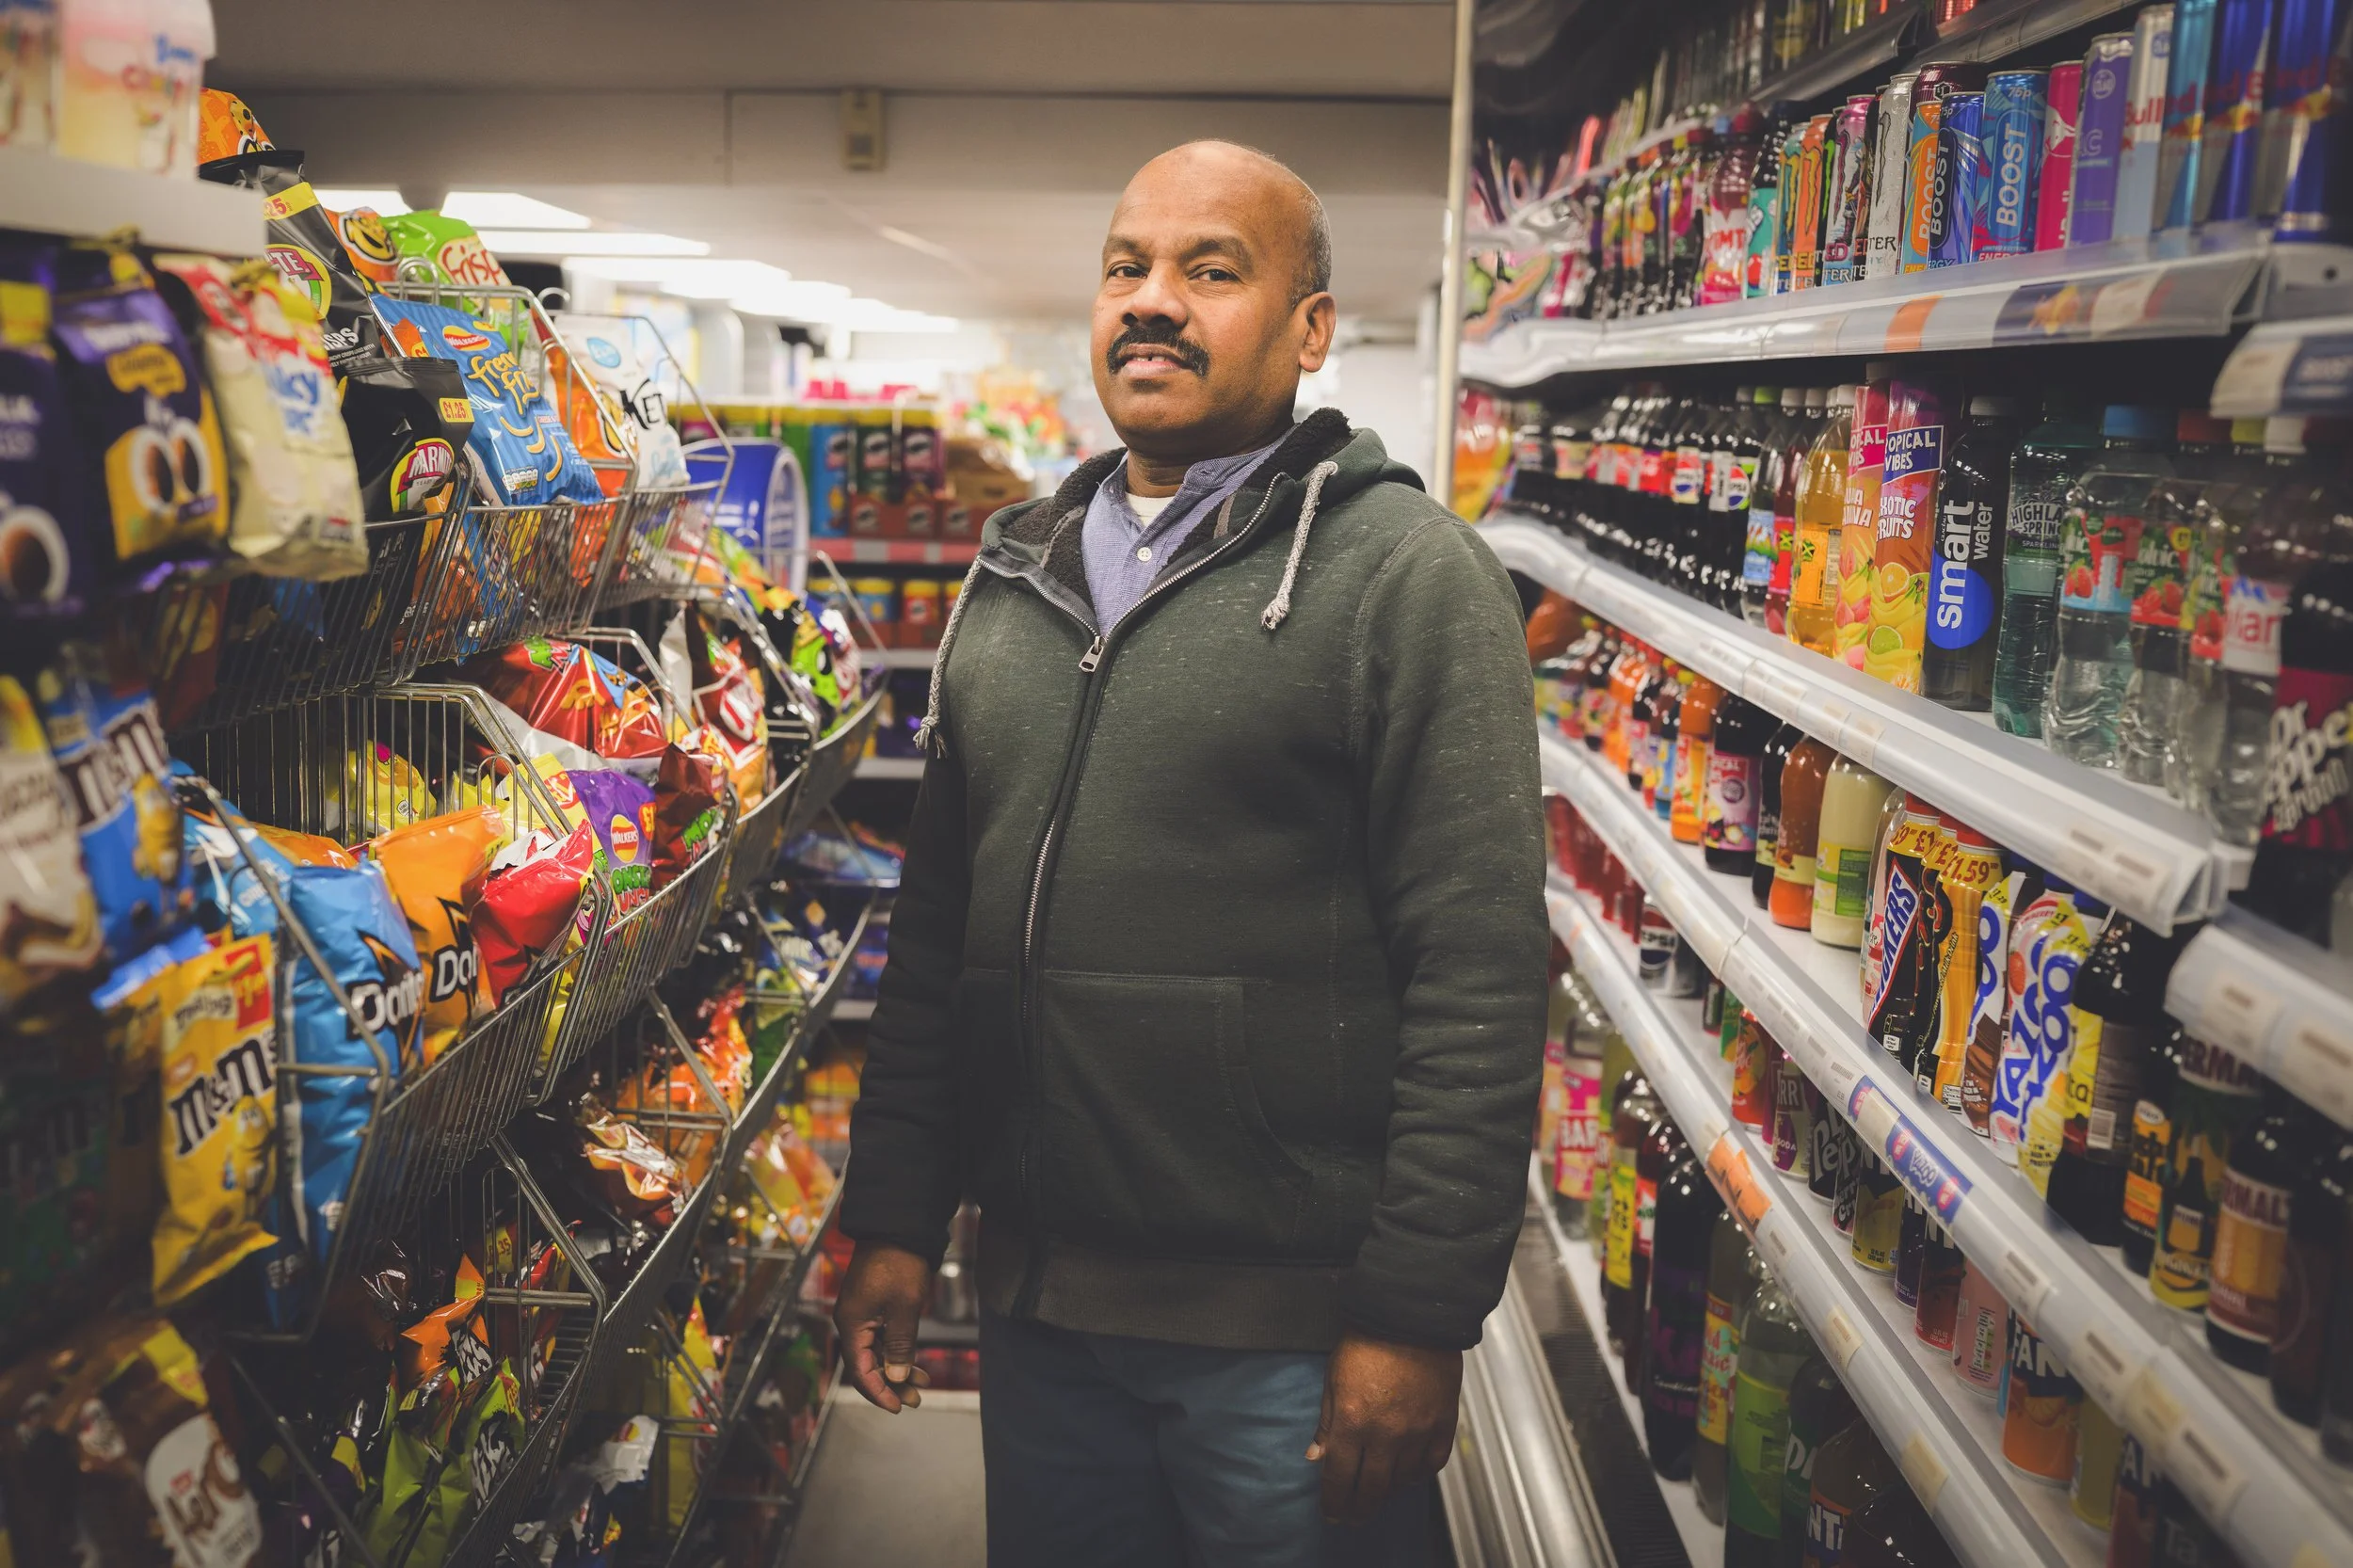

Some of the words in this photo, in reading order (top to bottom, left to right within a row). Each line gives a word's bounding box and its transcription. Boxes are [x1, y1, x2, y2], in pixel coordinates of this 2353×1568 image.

[1995, 123, 2025, 227] BOOST
[1930, 140, 1949, 235] BOOST
[442, 401, 467, 420] £1.25
[1885, 430, 1936, 455] OPICAL
[1885, 452, 1913, 471] VIBES
[1880, 496, 1917, 519] XOTIC
[2011, 502, 2063, 526] HIGHLA
[1974, 502, 1993, 560] water
[2023, 540, 2059, 549] SPARKLIN
[1937, 500, 1975, 629] smart
[613, 829, 639, 844] WALKERS
